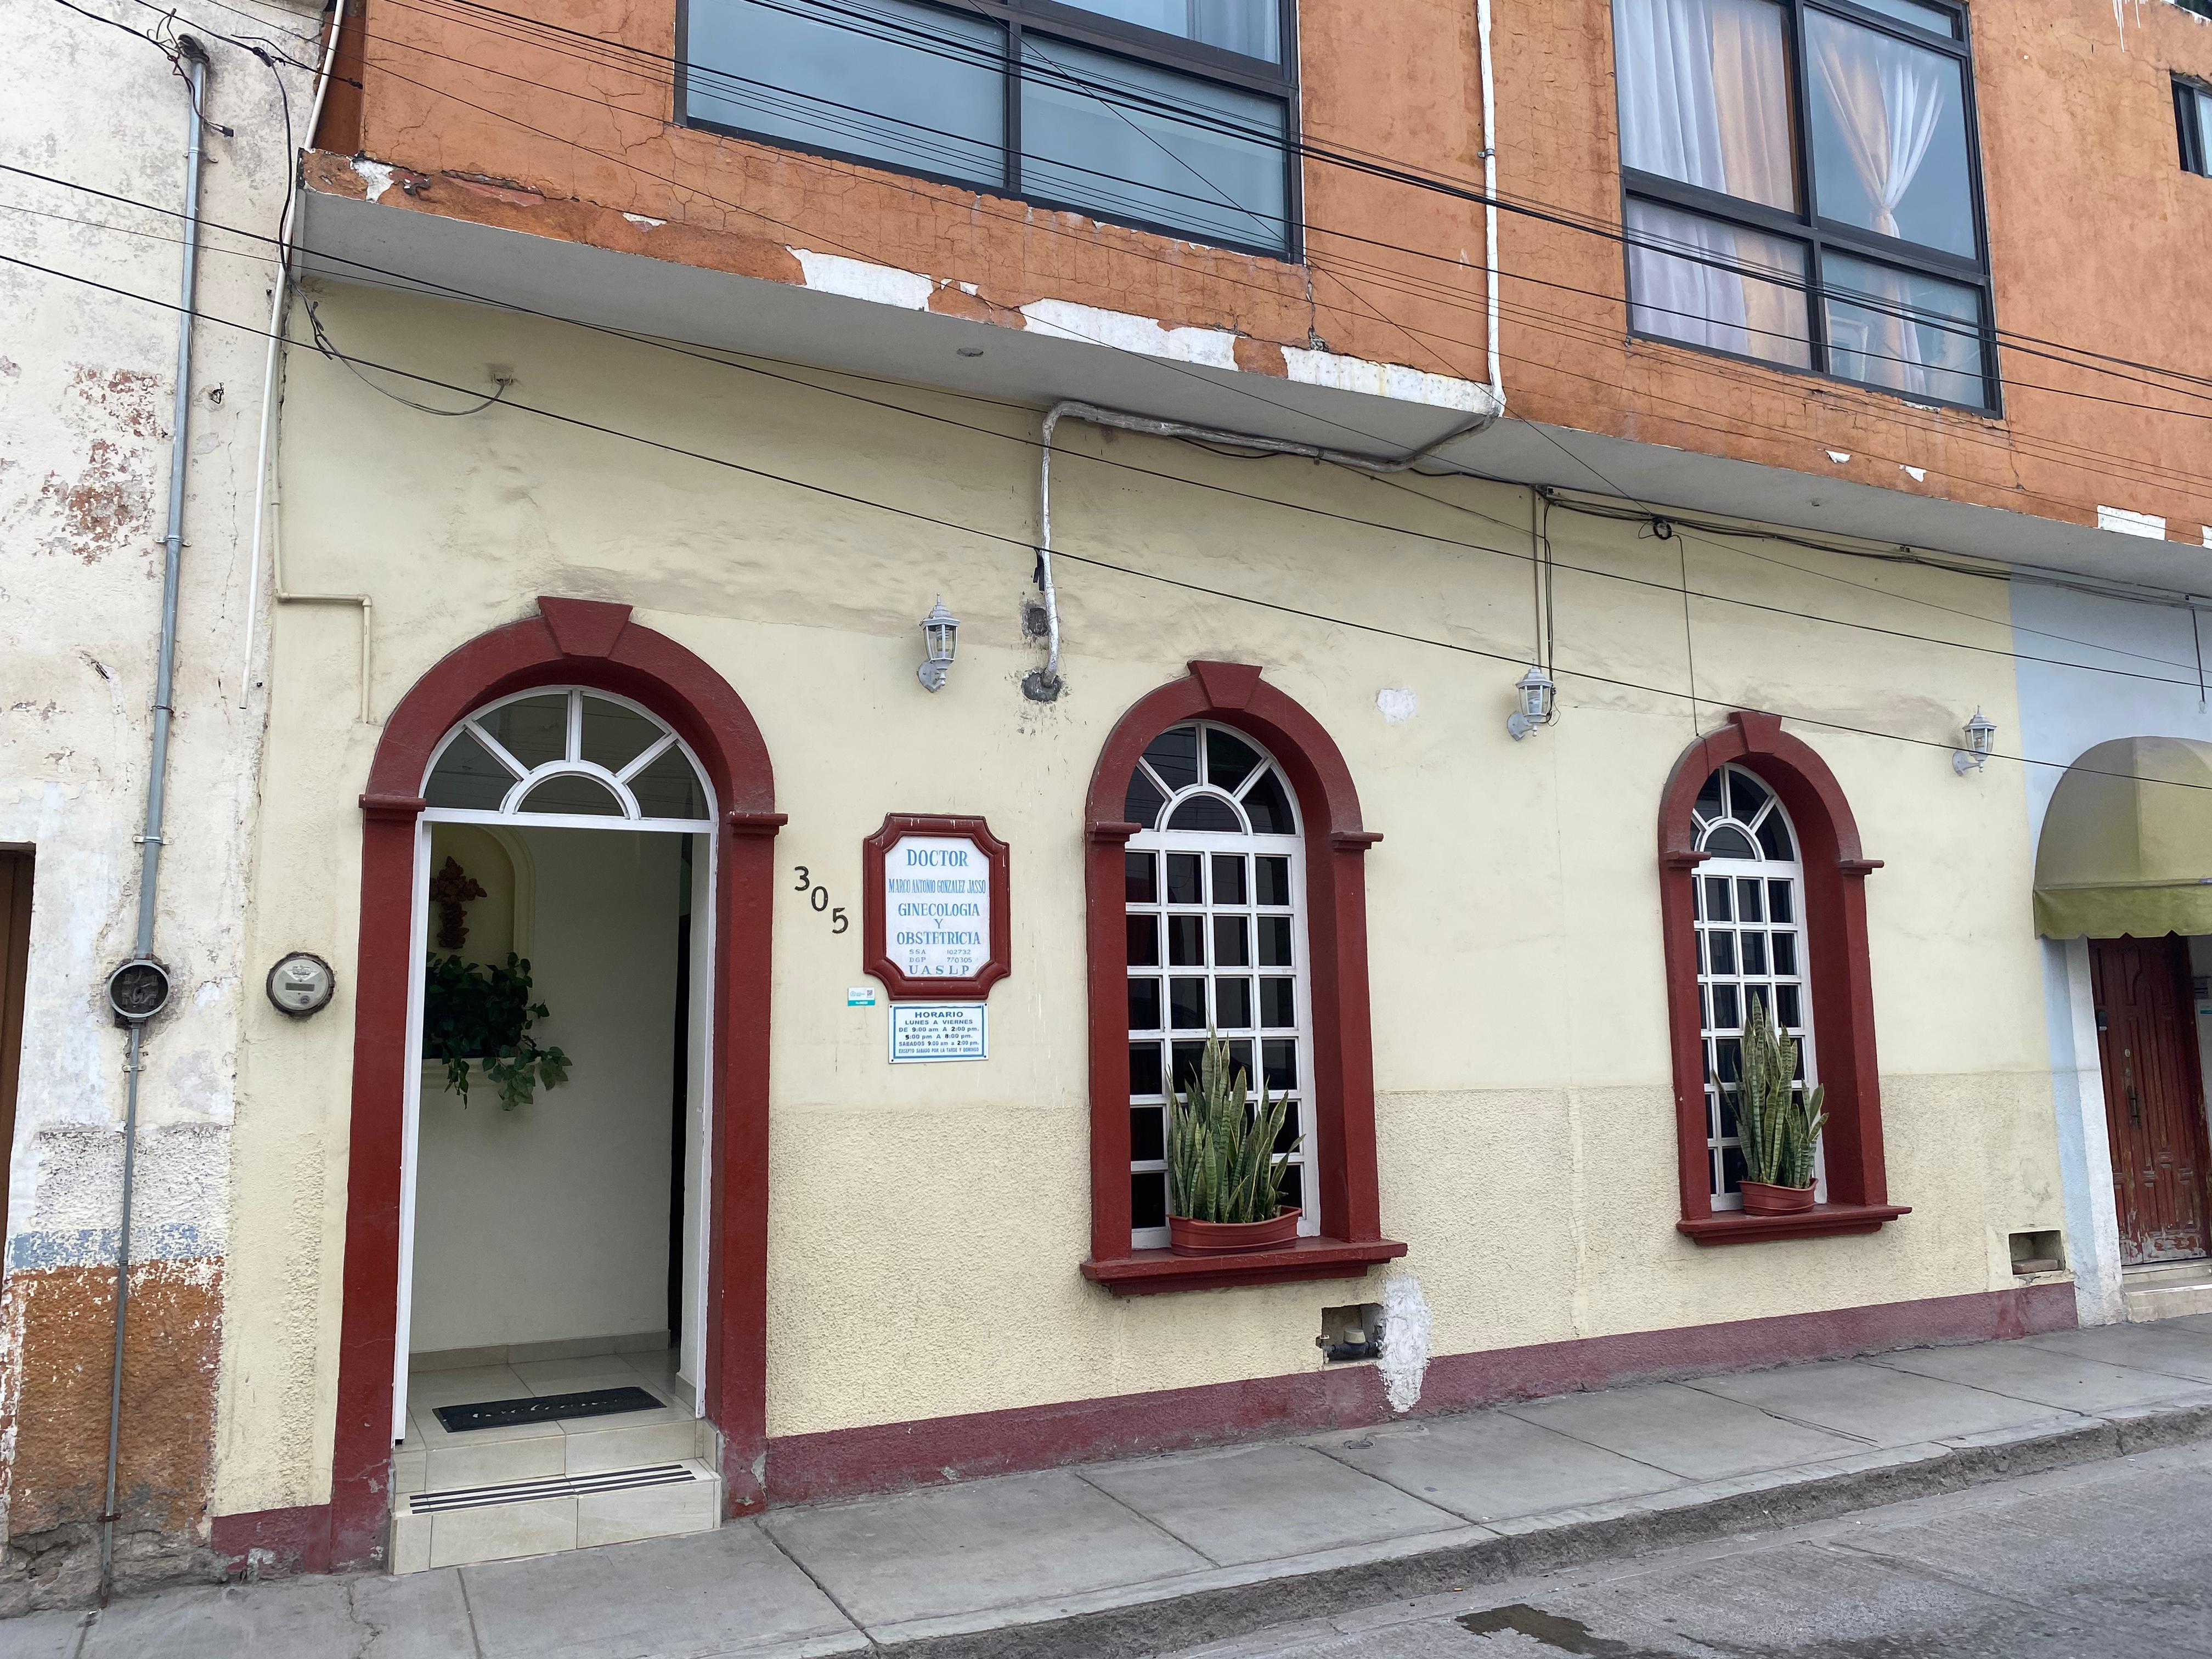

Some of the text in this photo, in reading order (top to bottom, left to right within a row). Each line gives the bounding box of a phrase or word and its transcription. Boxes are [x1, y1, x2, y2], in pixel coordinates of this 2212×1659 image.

[906, 849, 969, 866] DOCTOR
[888, 878, 985, 893] MARCO ANTONIO GONZALEZ JASSO
[794, 866, 849, 934] 305
[898, 903, 980, 916] GINECOLOGIA
[934, 919, 943, 929] Y
[897, 932, 981, 945] OBSTETRICIA
